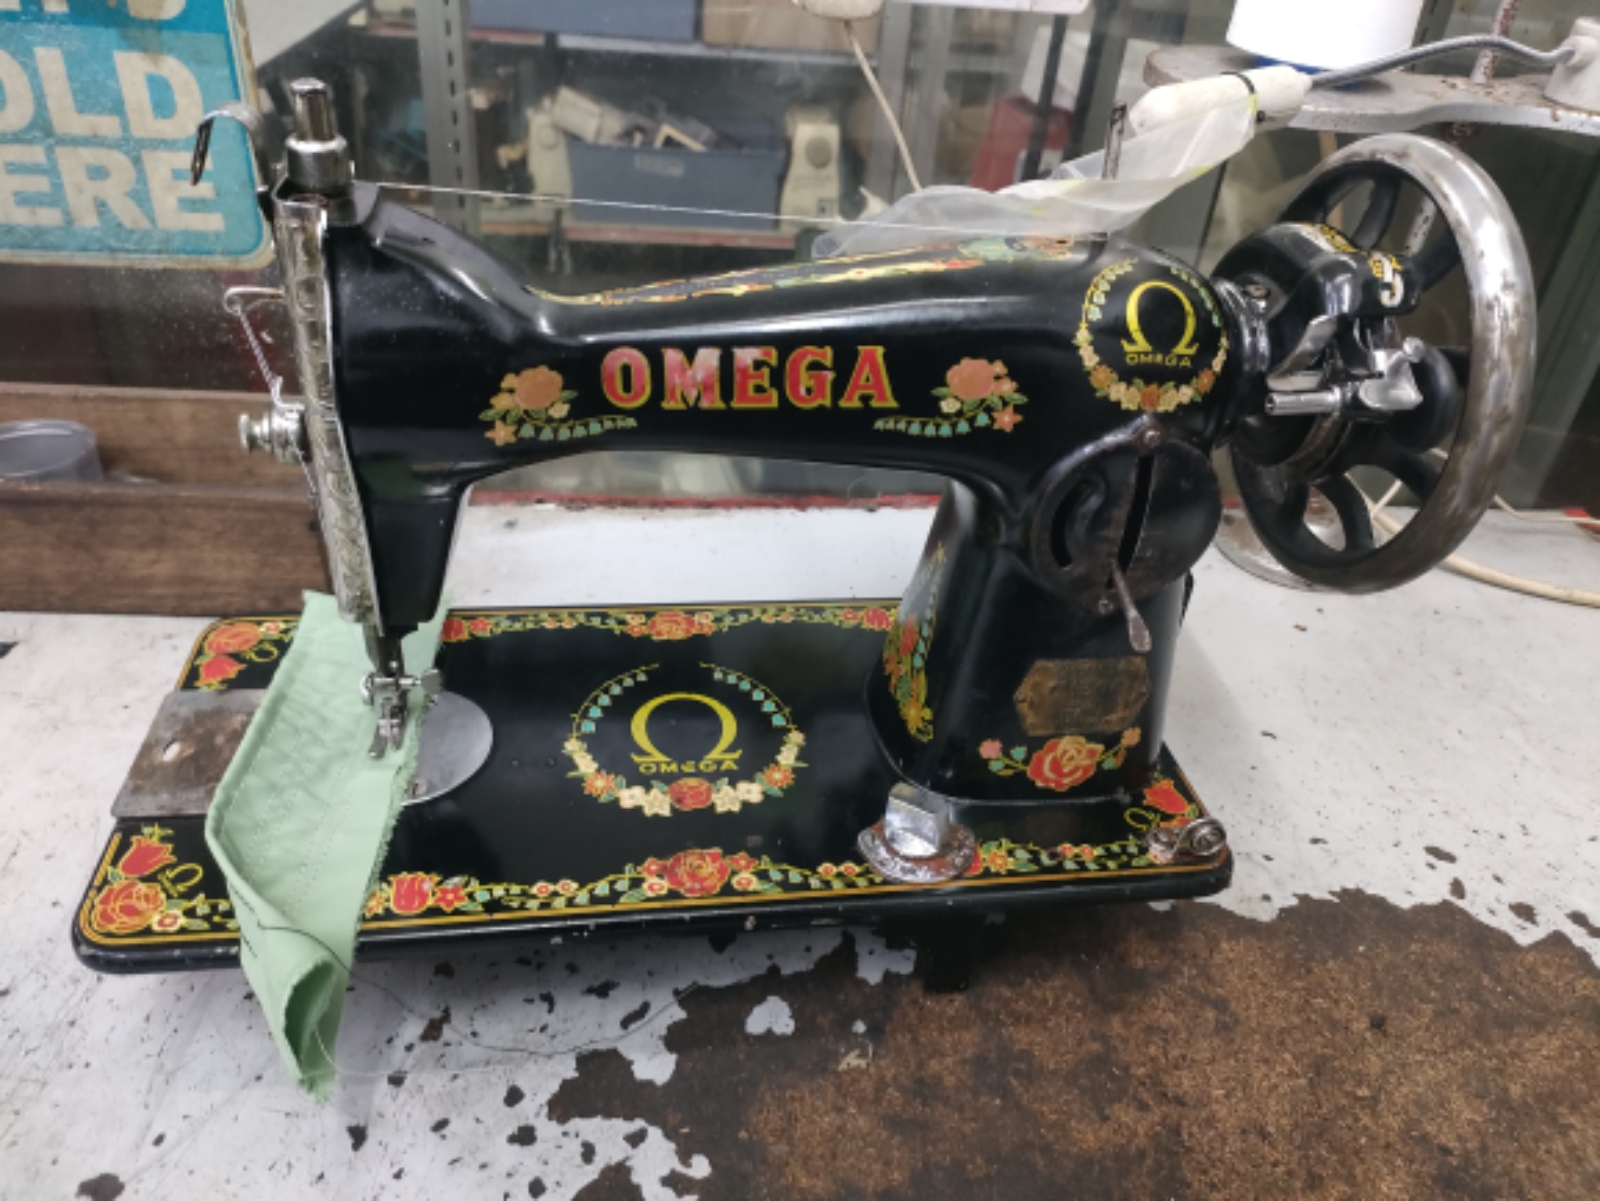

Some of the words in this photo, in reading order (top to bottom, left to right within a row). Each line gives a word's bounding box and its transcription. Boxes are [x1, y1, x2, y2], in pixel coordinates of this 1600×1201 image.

[0, 144, 225, 232] ERE
[600, 345, 899, 409] OMEGA
[1125, 352, 1192, 368] OMEGA
[638, 759, 740, 775] OMEGA
